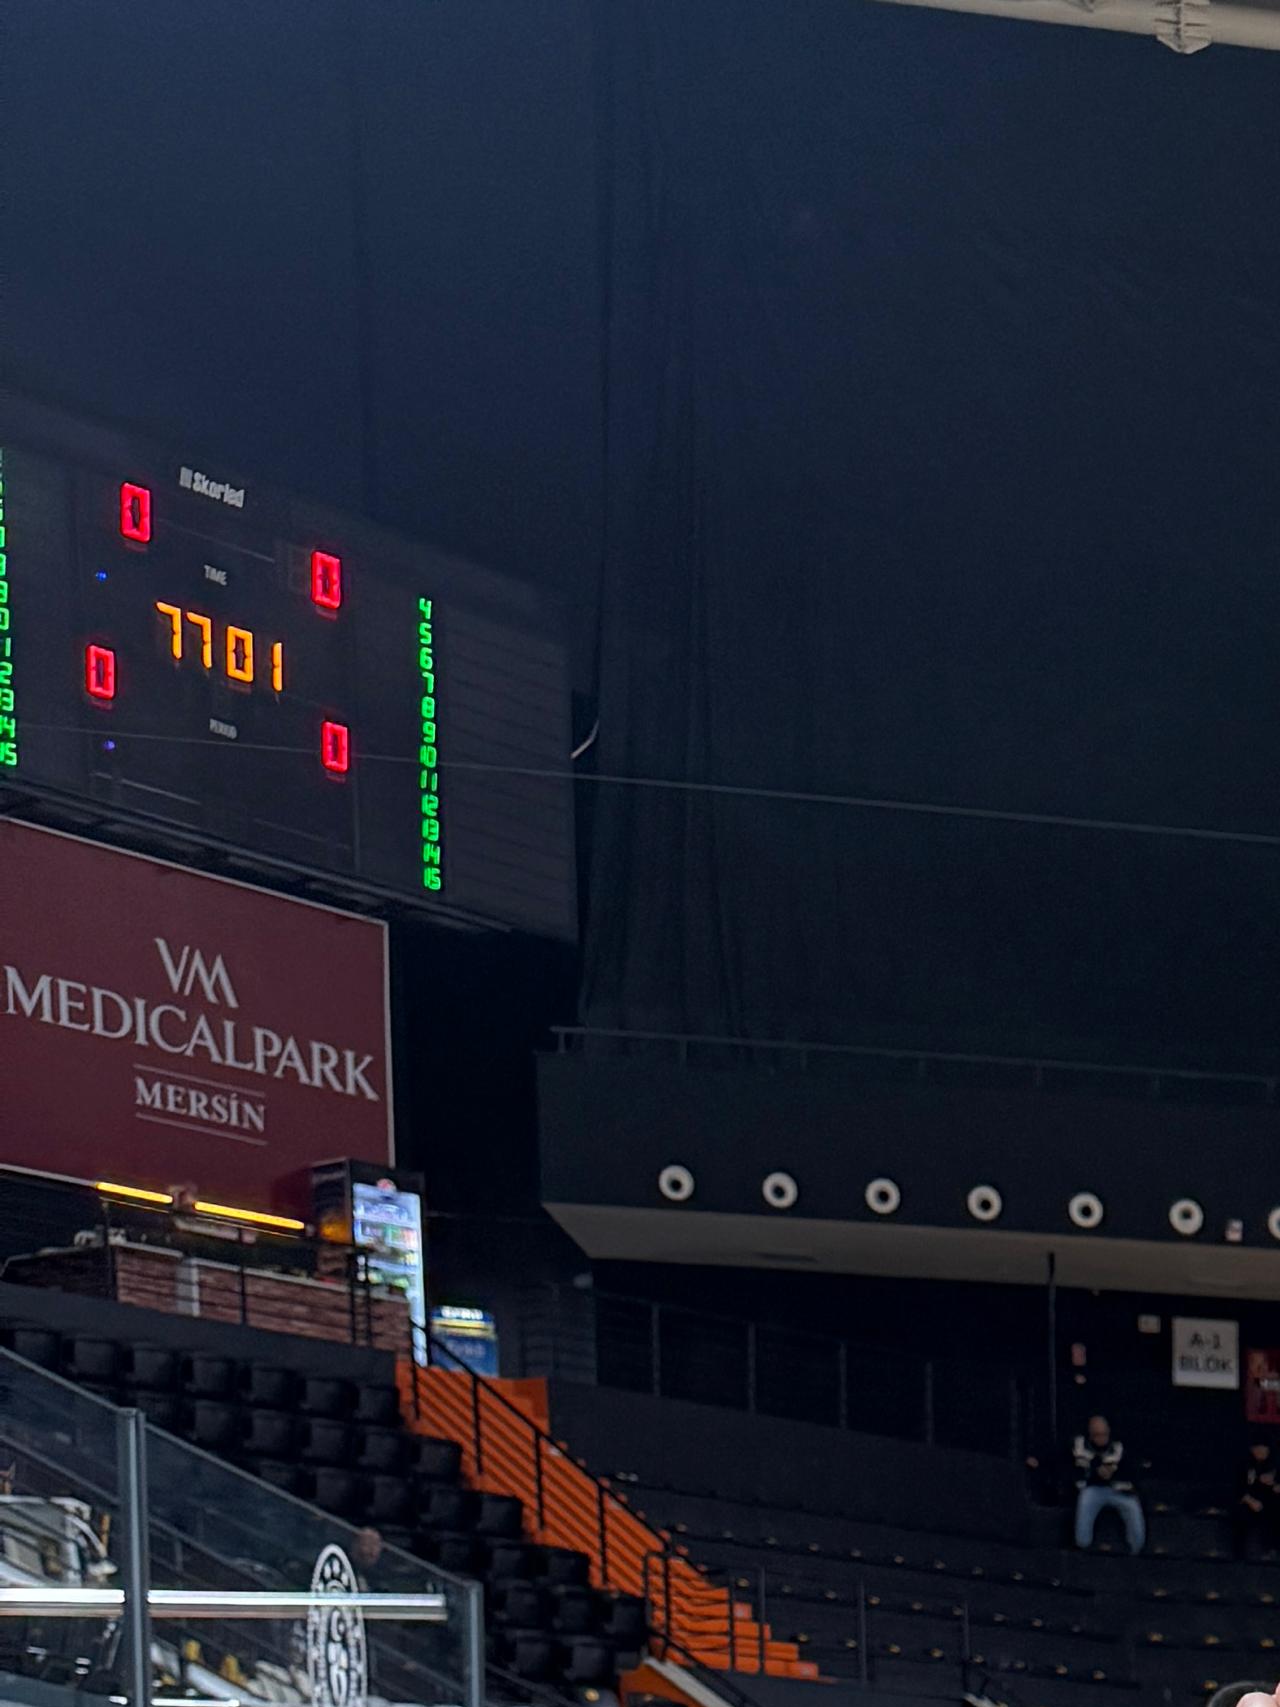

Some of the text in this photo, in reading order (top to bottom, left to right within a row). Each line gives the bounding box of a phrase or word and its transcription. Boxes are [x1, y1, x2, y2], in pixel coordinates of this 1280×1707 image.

[121, 482, 151, 543] 0
[312, 550, 341, 609] 0
[86, 644, 115, 700] 0
[321, 719, 348, 774] 0
[134, 1075, 266, 1132] MERSİN
